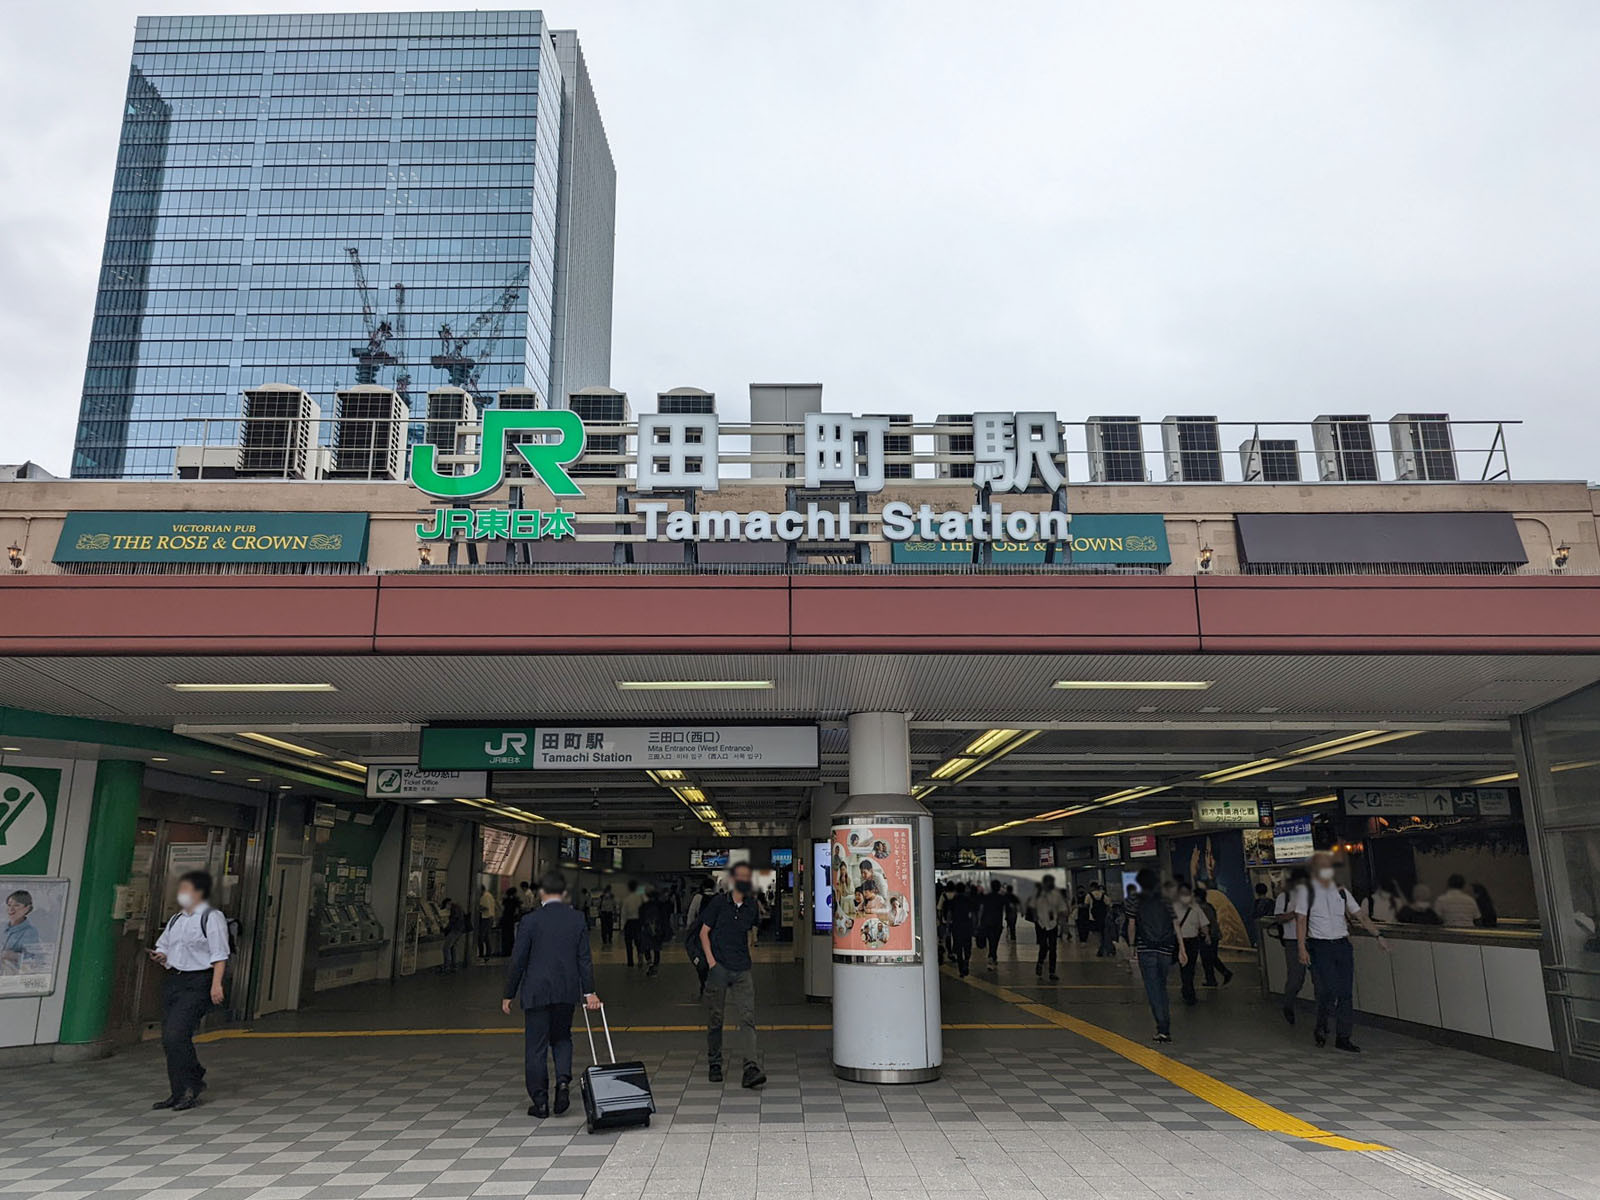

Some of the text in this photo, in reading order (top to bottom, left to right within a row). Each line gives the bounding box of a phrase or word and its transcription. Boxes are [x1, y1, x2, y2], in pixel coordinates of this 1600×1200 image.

[409, 408, 586, 499] JR
[637, 411, 1066, 494] 田町駅
[172, 524, 256, 533] VICTORIAN PUB
[415, 507, 576, 541] JR東日本
[636, 501, 1070, 542] Tamachi Station
[112, 535, 309, 550] THE ROSE & CROWN
[484, 732, 527, 756] JR
[541, 732, 604, 750] 田町駅
[541, 752, 632, 763] Tamachi Station
[1454, 792, 1476, 804] JR
